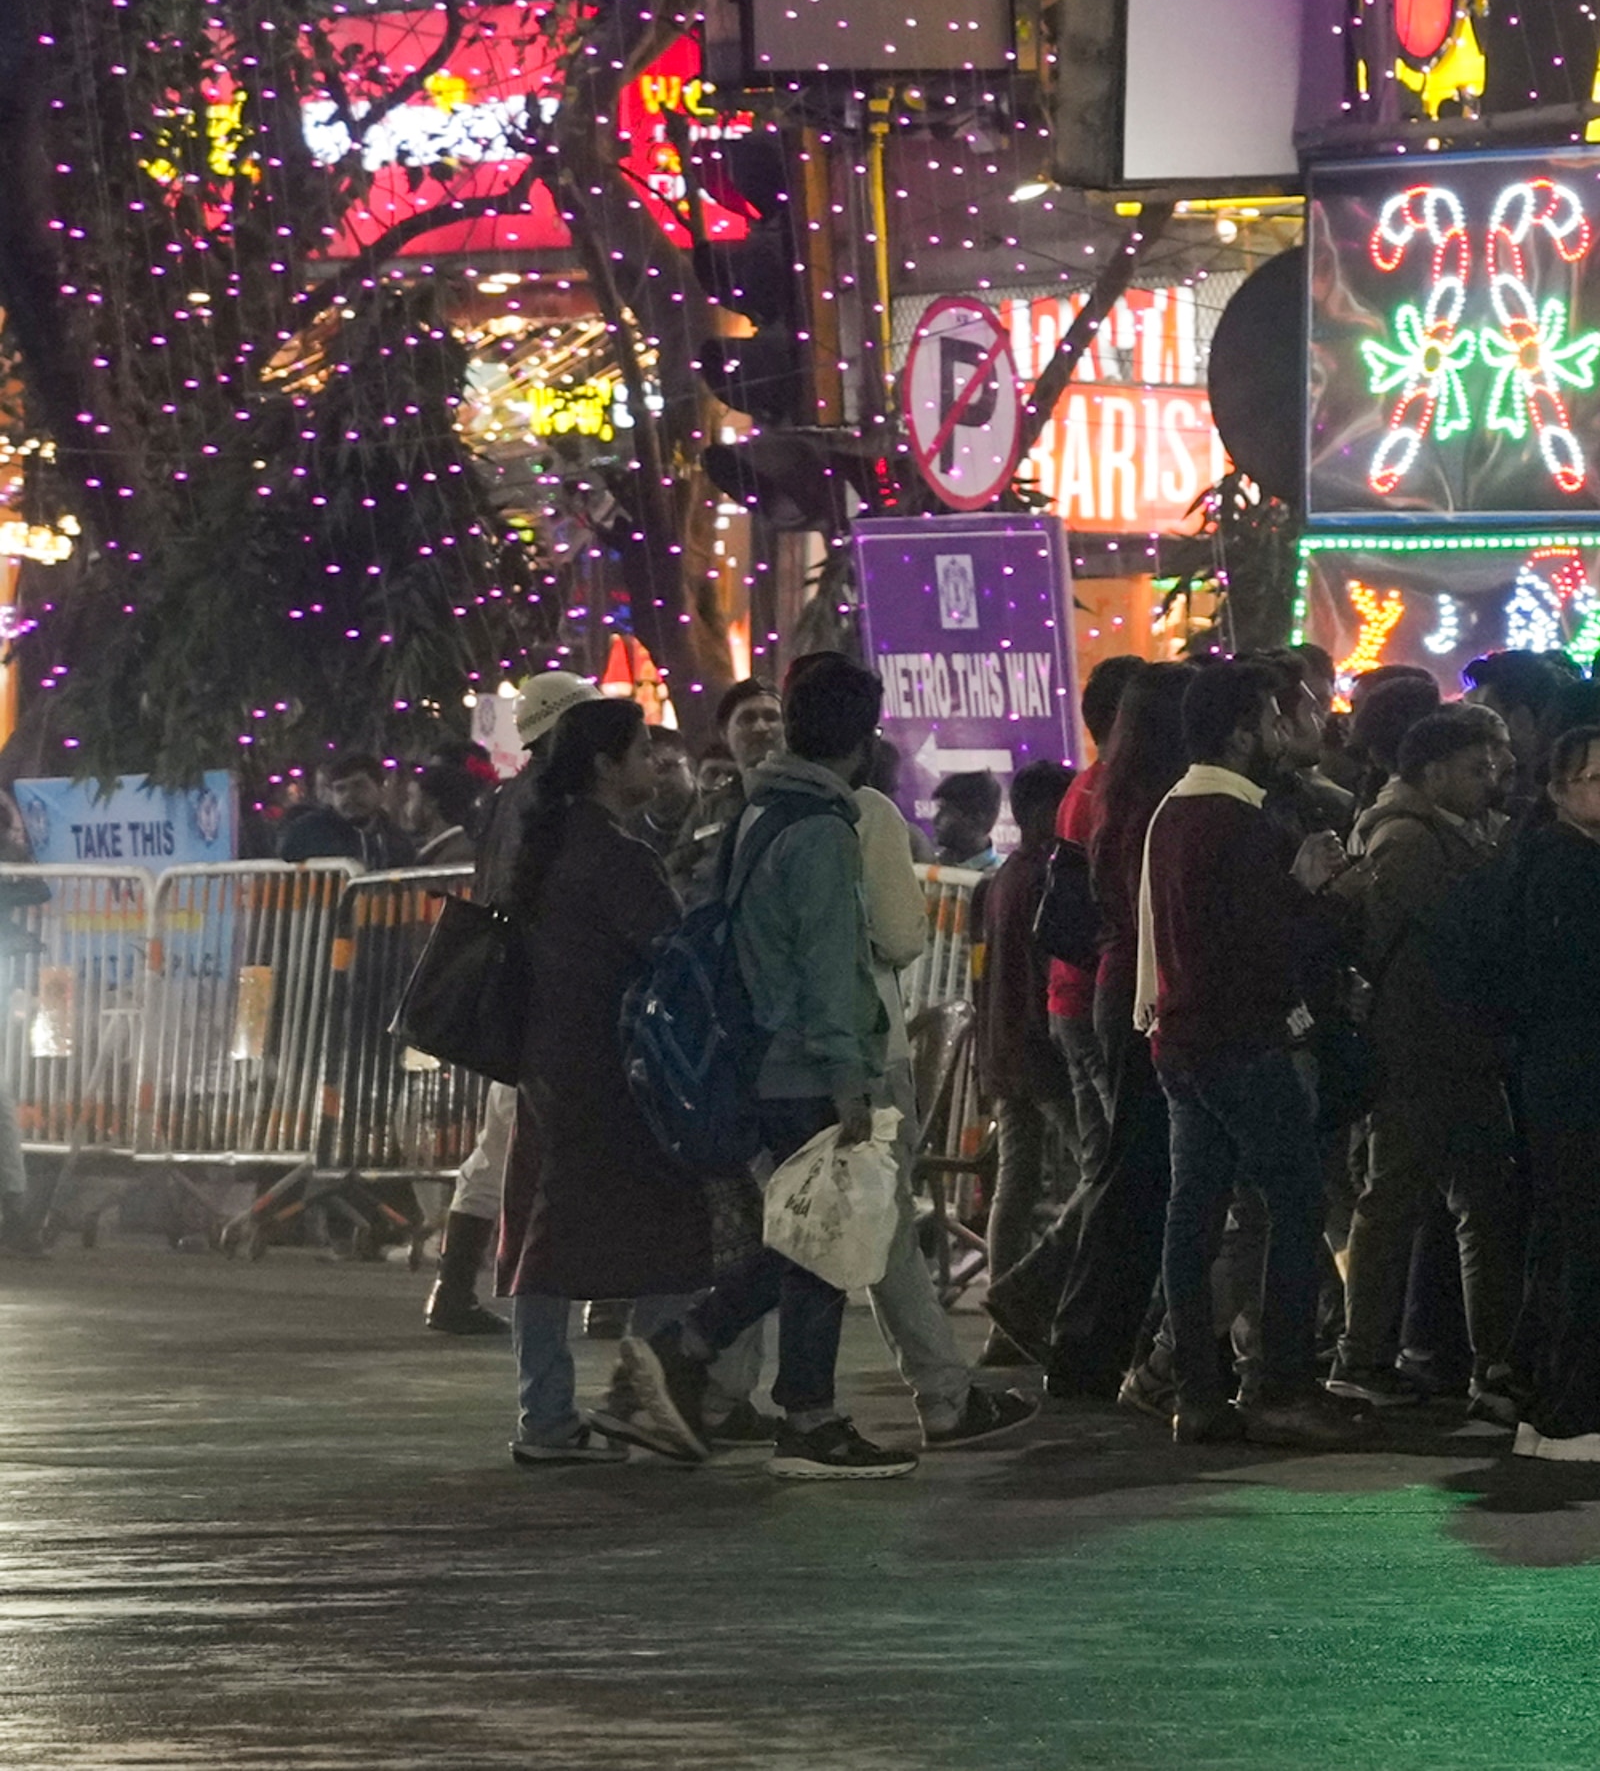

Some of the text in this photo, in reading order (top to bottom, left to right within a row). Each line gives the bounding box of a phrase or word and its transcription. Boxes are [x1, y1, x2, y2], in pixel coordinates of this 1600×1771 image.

[940, 336, 998, 475] P
[1016, 393, 1226, 521] BARIST
[878, 652, 1051, 718] METRO THIS WAY
[71, 821, 175, 859] TAKE THIS
